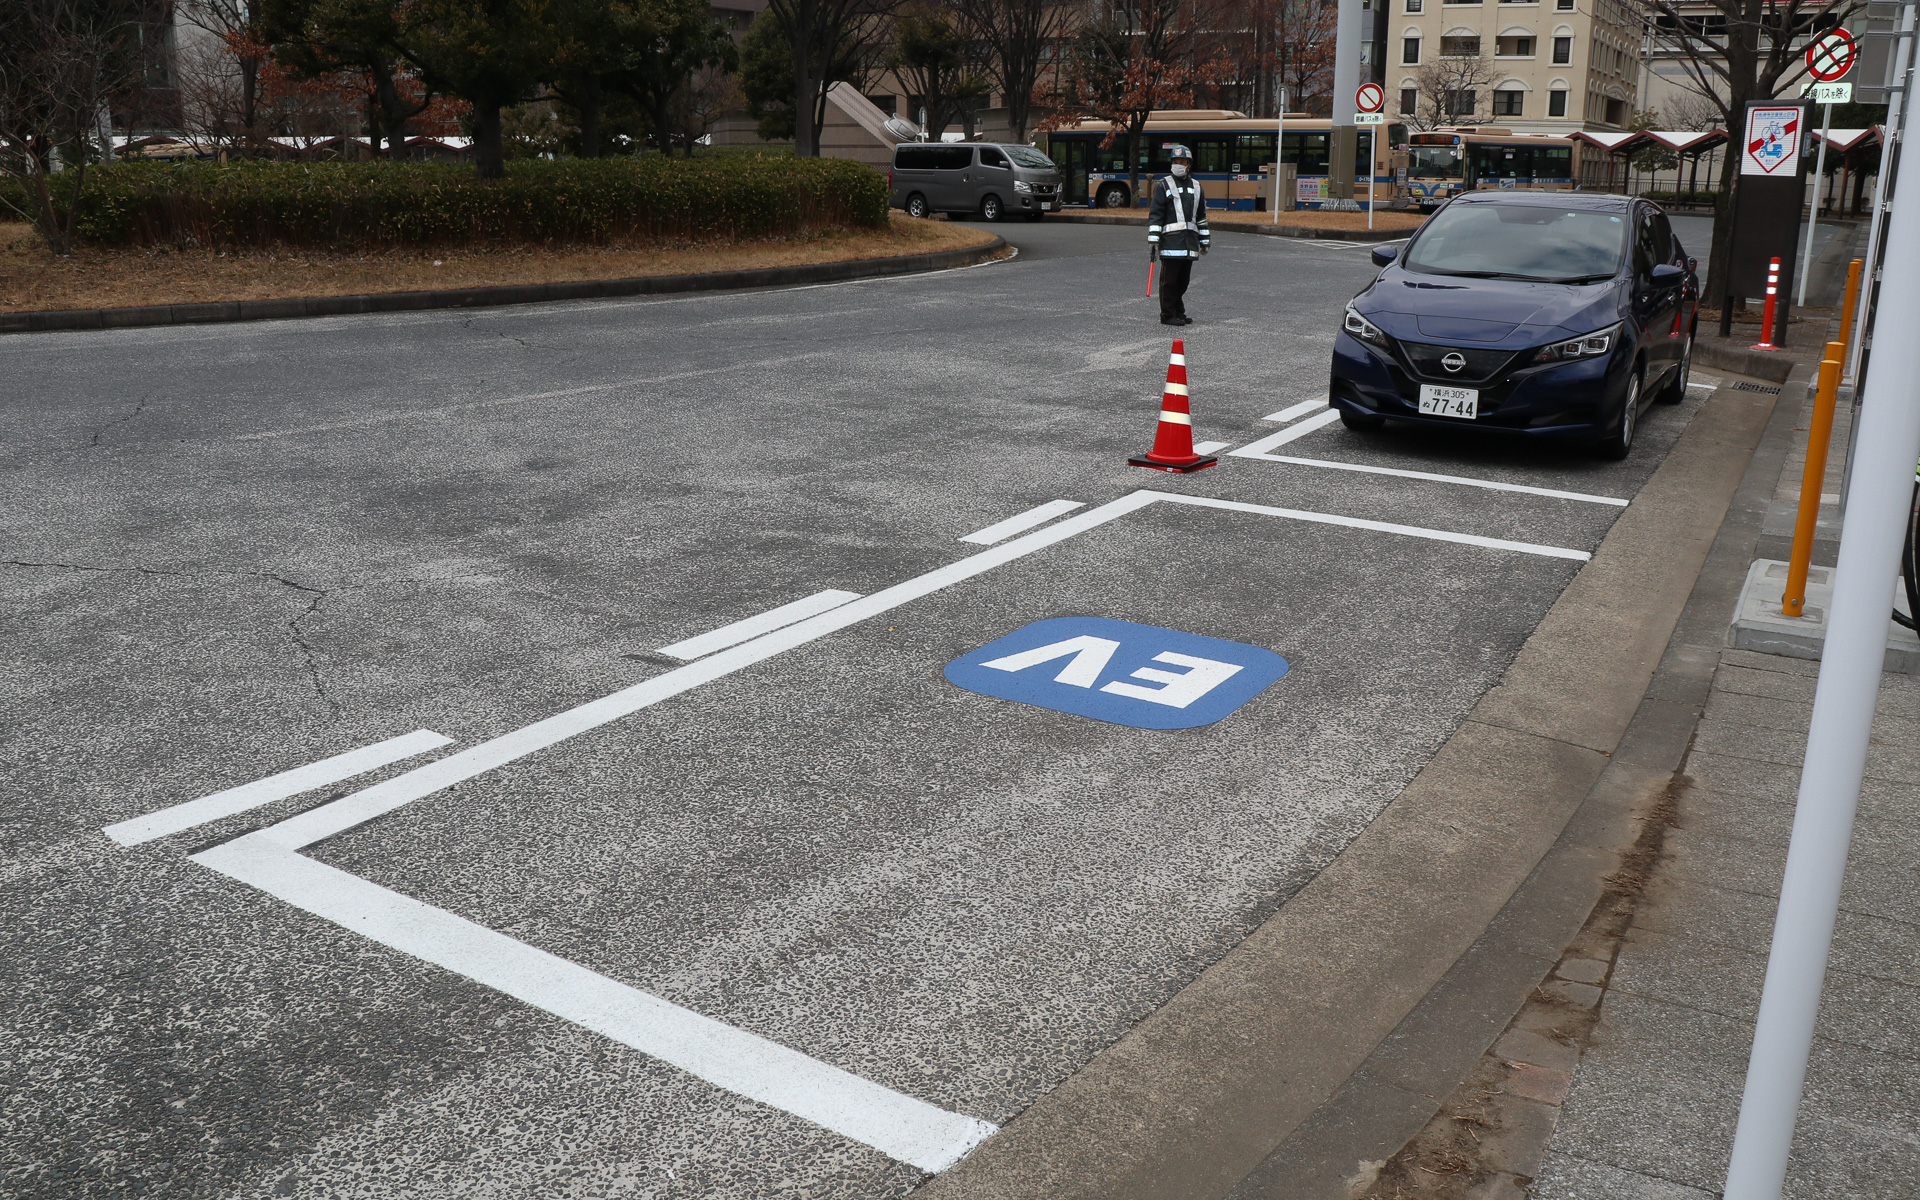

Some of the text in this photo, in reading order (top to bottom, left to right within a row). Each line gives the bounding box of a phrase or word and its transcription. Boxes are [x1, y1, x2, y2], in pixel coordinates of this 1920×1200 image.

[1434, 388, 1465, 399] 横浜 305
[1432, 398, 1474, 416] 77-44
[978, 634, 1245, 710] EV
